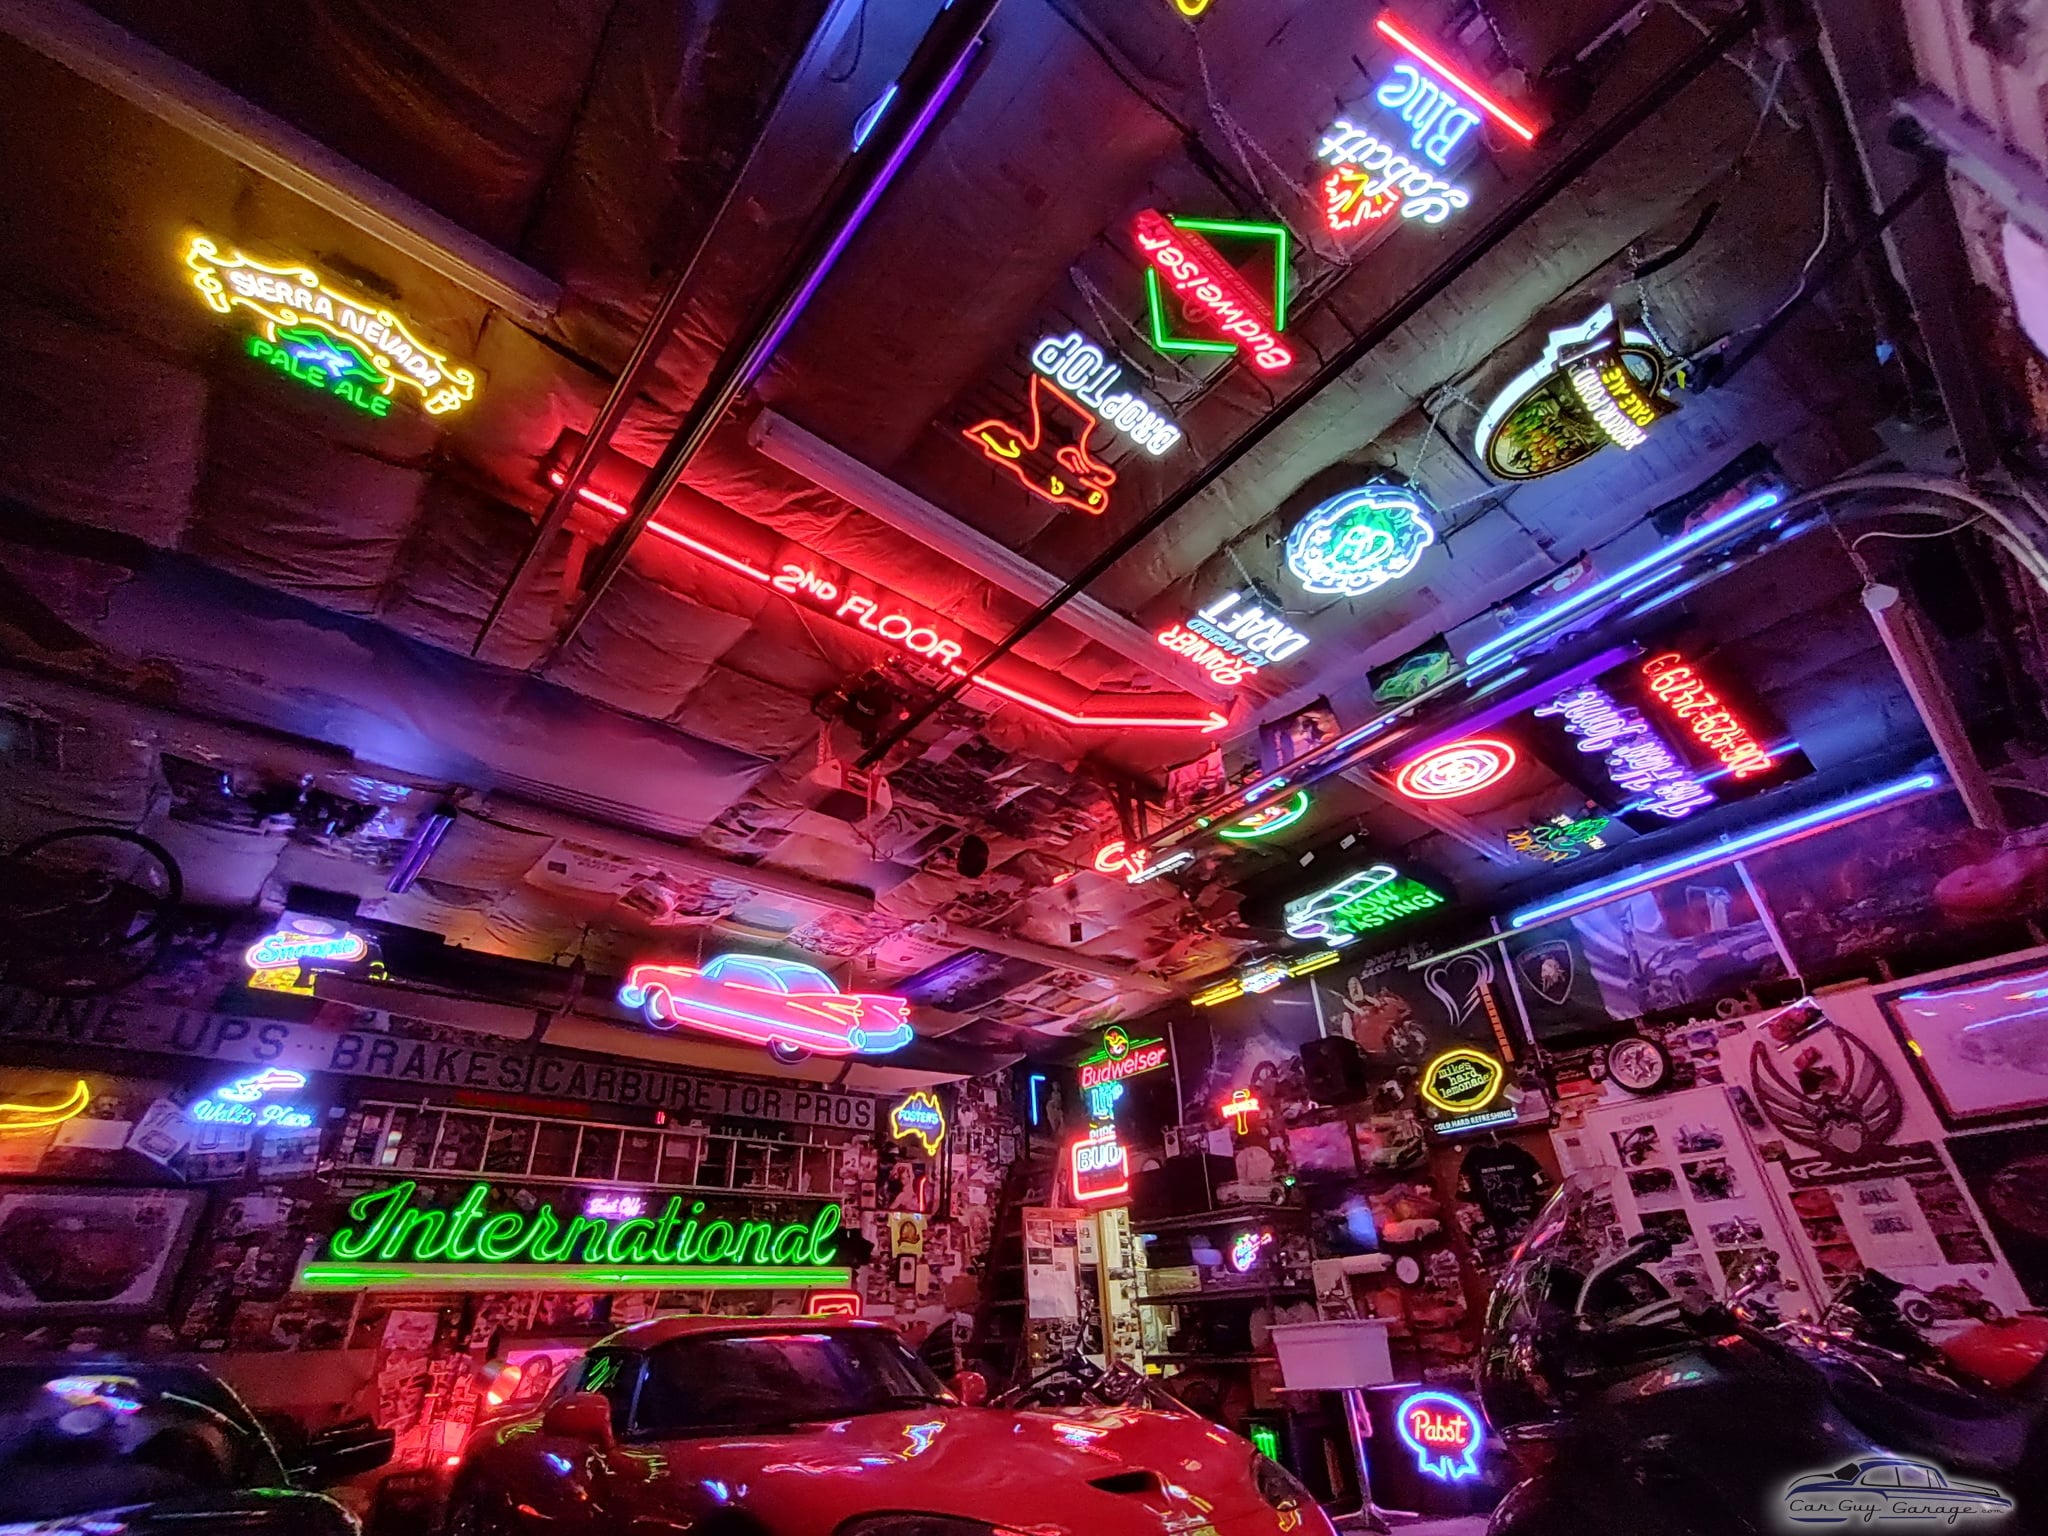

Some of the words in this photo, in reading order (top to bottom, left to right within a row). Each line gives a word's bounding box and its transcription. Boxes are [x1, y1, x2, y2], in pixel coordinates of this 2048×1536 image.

[1376, 64, 1480, 167] Blue
[1318, 121, 1469, 223] Labatt
[1138, 233, 1292, 371] Budweiser
[229, 270, 335, 320] SIERRA
[340, 307, 442, 387] NEVADA
[253, 338, 328, 388] PALE
[334, 380, 391, 416] ALE
[1032, 333, 1122, 408] TOP
[1601, 367, 1631, 395] ALE
[1100, 393, 1181, 455] DROP
[1592, 401, 1648, 452] MIRROR
[1618, 394, 1655, 426] PALE
[771, 564, 838, 602] 2ND
[836, 595, 964, 667] FLOOR
[1196, 593, 1311, 663] DRAFT
[1157, 623, 1258, 683] RAINIER
[1335, 891, 1445, 933] TASTING!
[1337, 889, 1399, 918] NOW
[170, 1012, 290, 1061] UPS
[329, 1034, 525, 1091] BRAKES
[537, 1058, 784, 1118] CARBURETOR
[794, 1092, 872, 1128] PROS
[1081, 1048, 1167, 1088] Budweiser
[1439, 1062, 1472, 1079] mike's
[1439, 1072, 1491, 1098] lemonade
[1448, 1067, 1479, 1087] hard
[193, 1099, 256, 1125] Walt's
[257, 1104, 312, 1127] Place
[1433, 1121, 1451, 1132] COLD
[1451, 1119, 1470, 1129] HARD
[1077, 1142, 1123, 1172] BUD
[331, 1180, 842, 1264] International
[1410, 1410, 1468, 1444] Pabst
